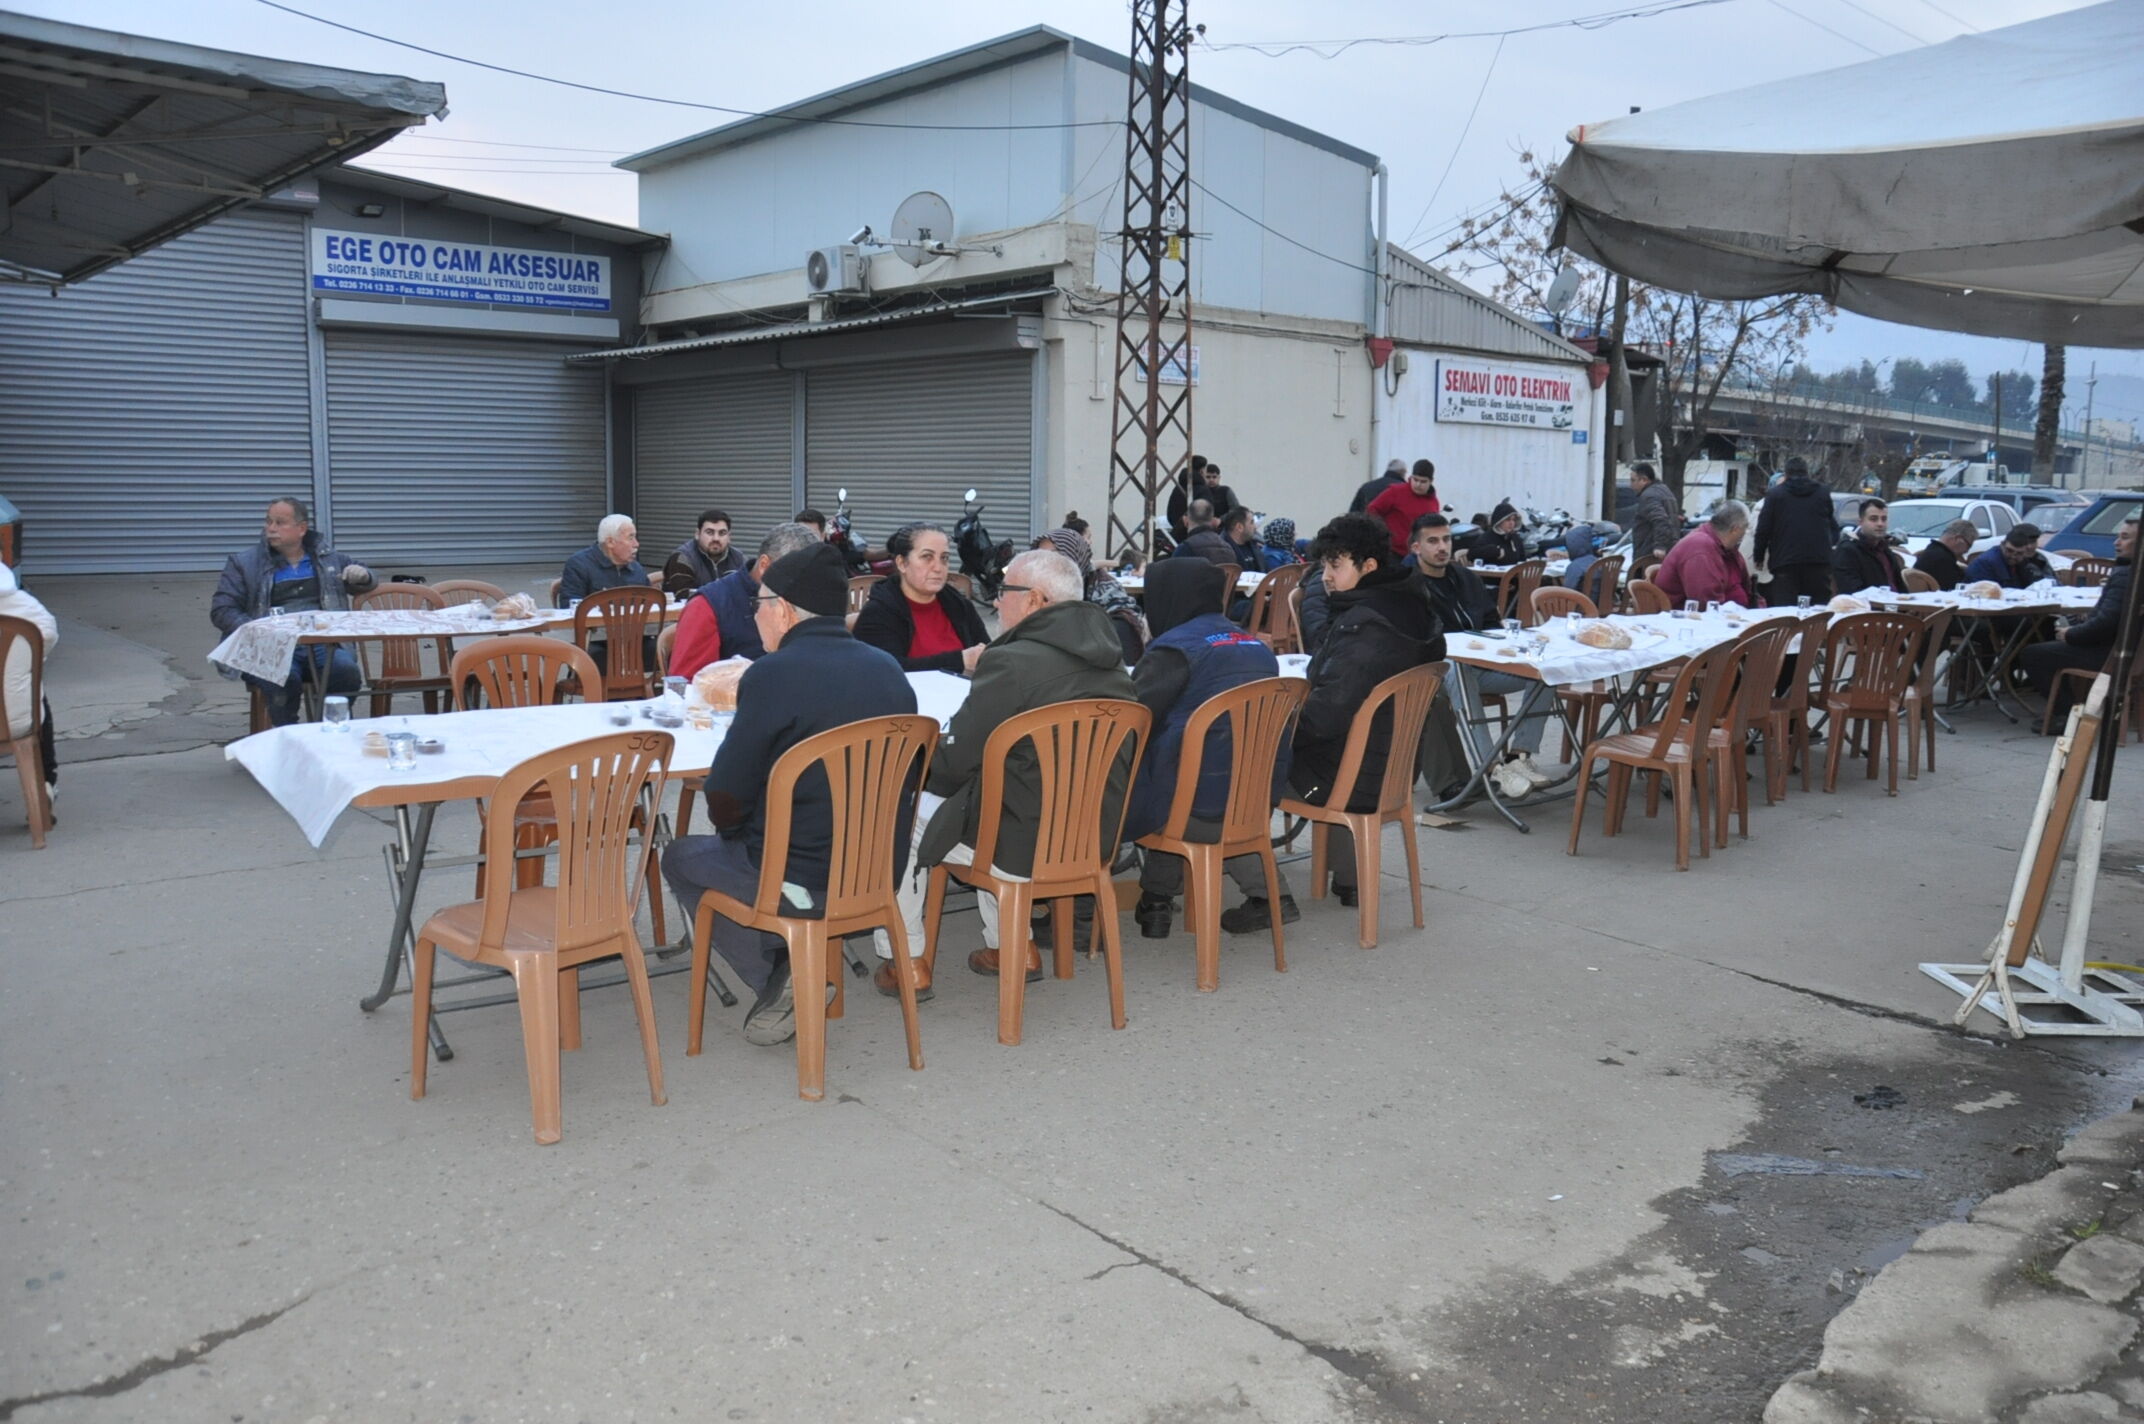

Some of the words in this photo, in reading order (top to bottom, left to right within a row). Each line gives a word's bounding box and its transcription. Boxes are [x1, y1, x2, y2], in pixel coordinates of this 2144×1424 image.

[326, 235, 373, 263] EGE
[379, 240, 426, 268] OTO
[433, 246, 481, 273] CAM
[488, 252, 600, 283] AKSESUAR
[528, 280, 545, 292] OTO
[547, 282, 566, 293] CAM
[1495, 373, 1518, 397] OTO
[1521, 375, 1572, 402] ELEKTRİK
